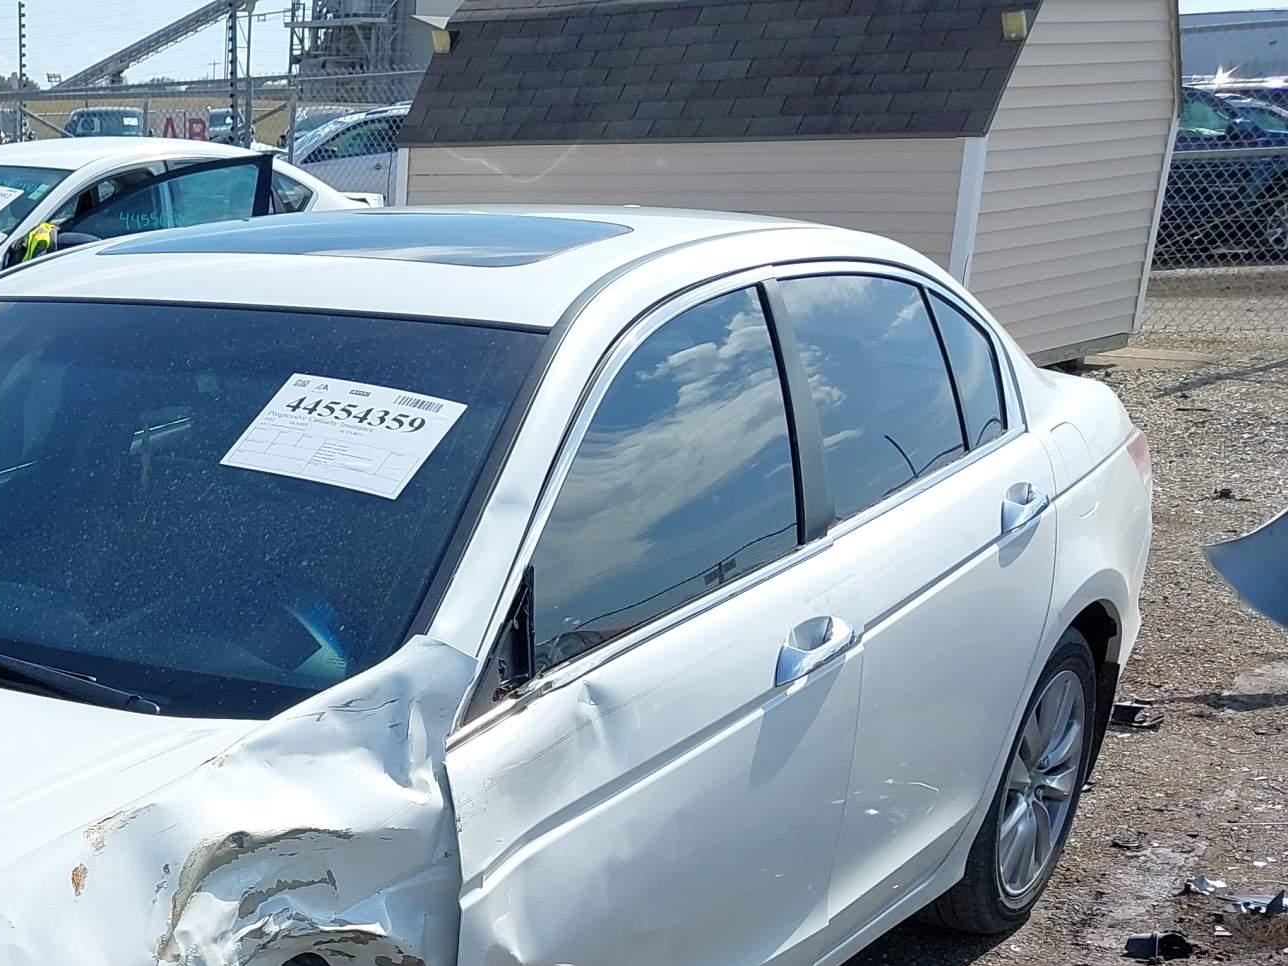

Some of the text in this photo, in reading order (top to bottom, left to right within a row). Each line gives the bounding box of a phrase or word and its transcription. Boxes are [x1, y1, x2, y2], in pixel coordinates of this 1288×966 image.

[268, 410, 307, 422] Progressive
[308, 415, 338, 427] Casualty
[340, 419, 375, 433] Insurance
[285, 396, 426, 433] 44554359
